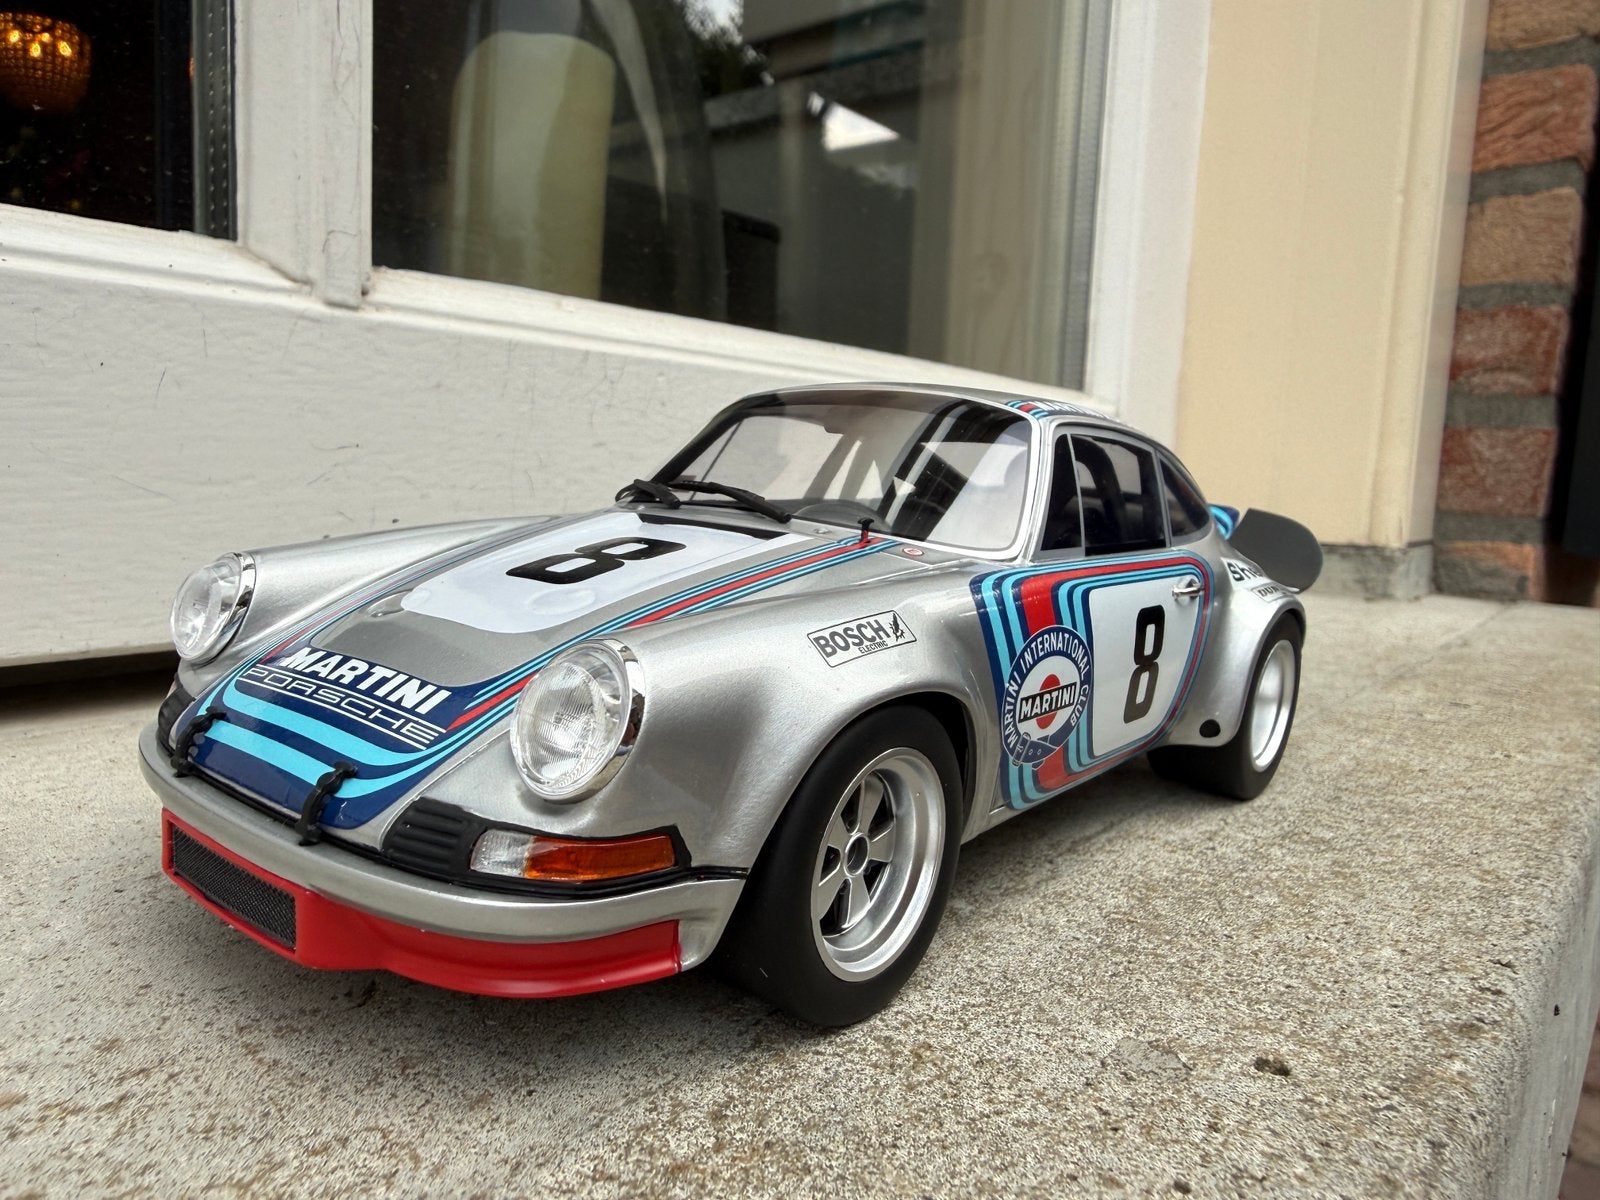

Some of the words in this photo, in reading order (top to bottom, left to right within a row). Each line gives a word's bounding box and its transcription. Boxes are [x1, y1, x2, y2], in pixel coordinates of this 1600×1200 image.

[505, 536, 687, 585] 8
[812, 619, 892, 659] BOSCH
[858, 640, 889, 654] ELECTRIC
[1123, 604, 1166, 724] 8
[244, 667, 439, 744] PORSCHE
[281, 647, 453, 715] MARTINI
[1004, 671, 1022, 749] MARTINI
[1019, 631, 1090, 681] INTERNATIONAL
[1069, 684, 1089, 727] CLUB
[1020, 684, 1077, 721] MARTINI
